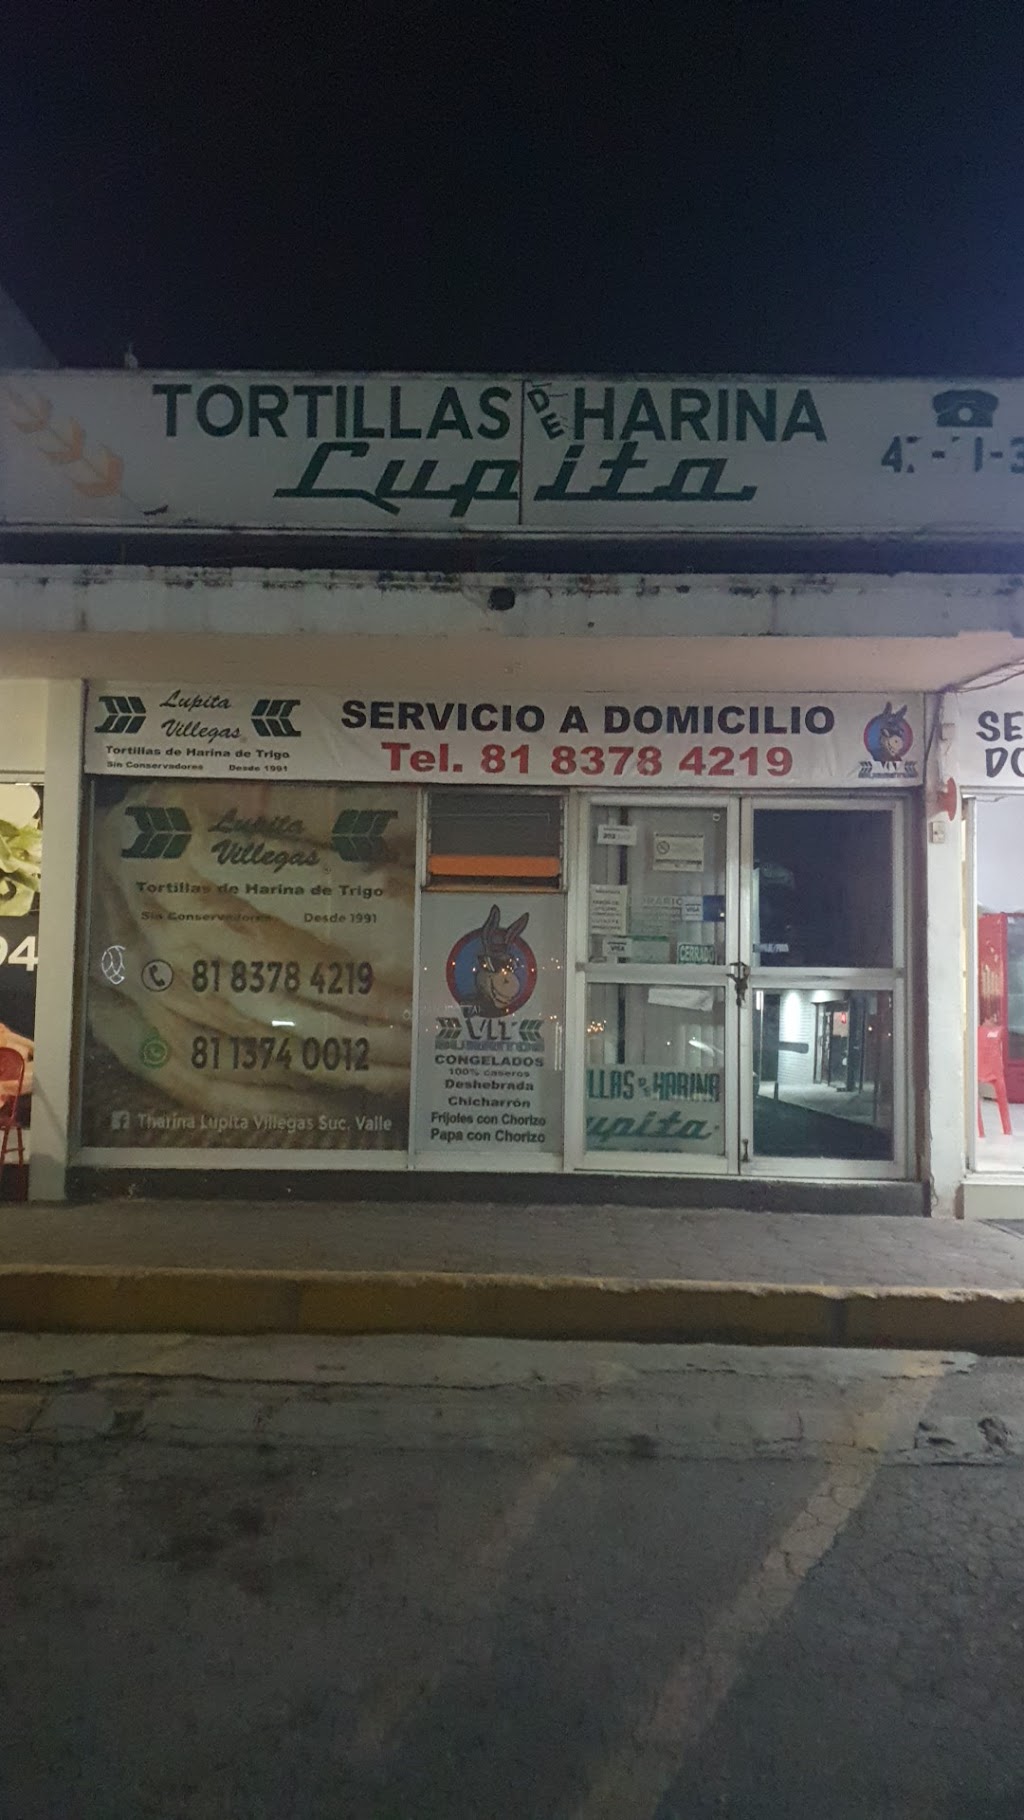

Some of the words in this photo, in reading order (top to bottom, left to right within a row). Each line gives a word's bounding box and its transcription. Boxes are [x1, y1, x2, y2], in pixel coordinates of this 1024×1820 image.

[152, 383, 512, 440] TORTILLAS
[527, 388, 565, 440] DE
[574, 387, 828, 443] HARINA
[273, 440, 758, 518] Lupita
[159, 689, 232, 712] Lupita
[341, 700, 545, 733] SERVICIO
[559, 705, 589, 733] A
[604, 705, 835, 735] DOMICILIO
[161, 718, 242, 744] Villegas
[106, 745, 161, 757] Tortillas
[165, 746, 182, 757] de
[186, 747, 231, 758] Harina
[235, 748, 251, 758] de
[256, 749, 290, 761] Trigo
[381, 742, 463, 773] Tel.
[480, 744, 529, 774] 81
[551, 745, 662, 776] 8378
[678, 746, 793, 776] 4219
[106, 760, 123, 768] Sin
[126, 761, 204, 771] Conservadores
[229, 764, 261, 772] Desde
[264, 764, 288, 772] 1991
[208, 808, 304, 838] Lupita
[210, 839, 321, 873] Villegas
[136, 881, 210, 896] Tortillas
[217, 881, 239, 895] de
[245, 882, 305, 896] Harina
[310, 884, 333, 897] de
[338, 884, 384, 899] Trigo
[304, 912, 346, 924] Desde
[350, 912, 377, 924] 1991
[680, 945, 715, 964] CERRADO
[192, 959, 220, 993] 81
[231, 959, 300, 993] 8378
[310, 961, 374, 995] 4219
[191, 1036, 220, 1069] 81
[229, 1036, 292, 1070] 1374
[302, 1037, 370, 1071] 0012
[435, 1054, 544, 1067] CONGELADOS
[450, 1068, 479, 1077] 100%
[484, 1069, 530, 1078] caseros
[444, 1079, 534, 1091] Deshebrada
[653, 1071, 720, 1103] HARINA
[448, 1096, 531, 1108] Chicharrón
[201, 1114, 248, 1134] Lupita
[253, 1115, 314, 1134] Villegas
[355, 1116, 392, 1131] Valle
[431, 1111, 473, 1125] Frijoles
[477, 1115, 498, 1125] con
[502, 1112, 546, 1126] Chorizo
[430, 1128, 463, 1142] Papa
[467, 1131, 490, 1141] con
[495, 1128, 546, 1143] Chorizo
